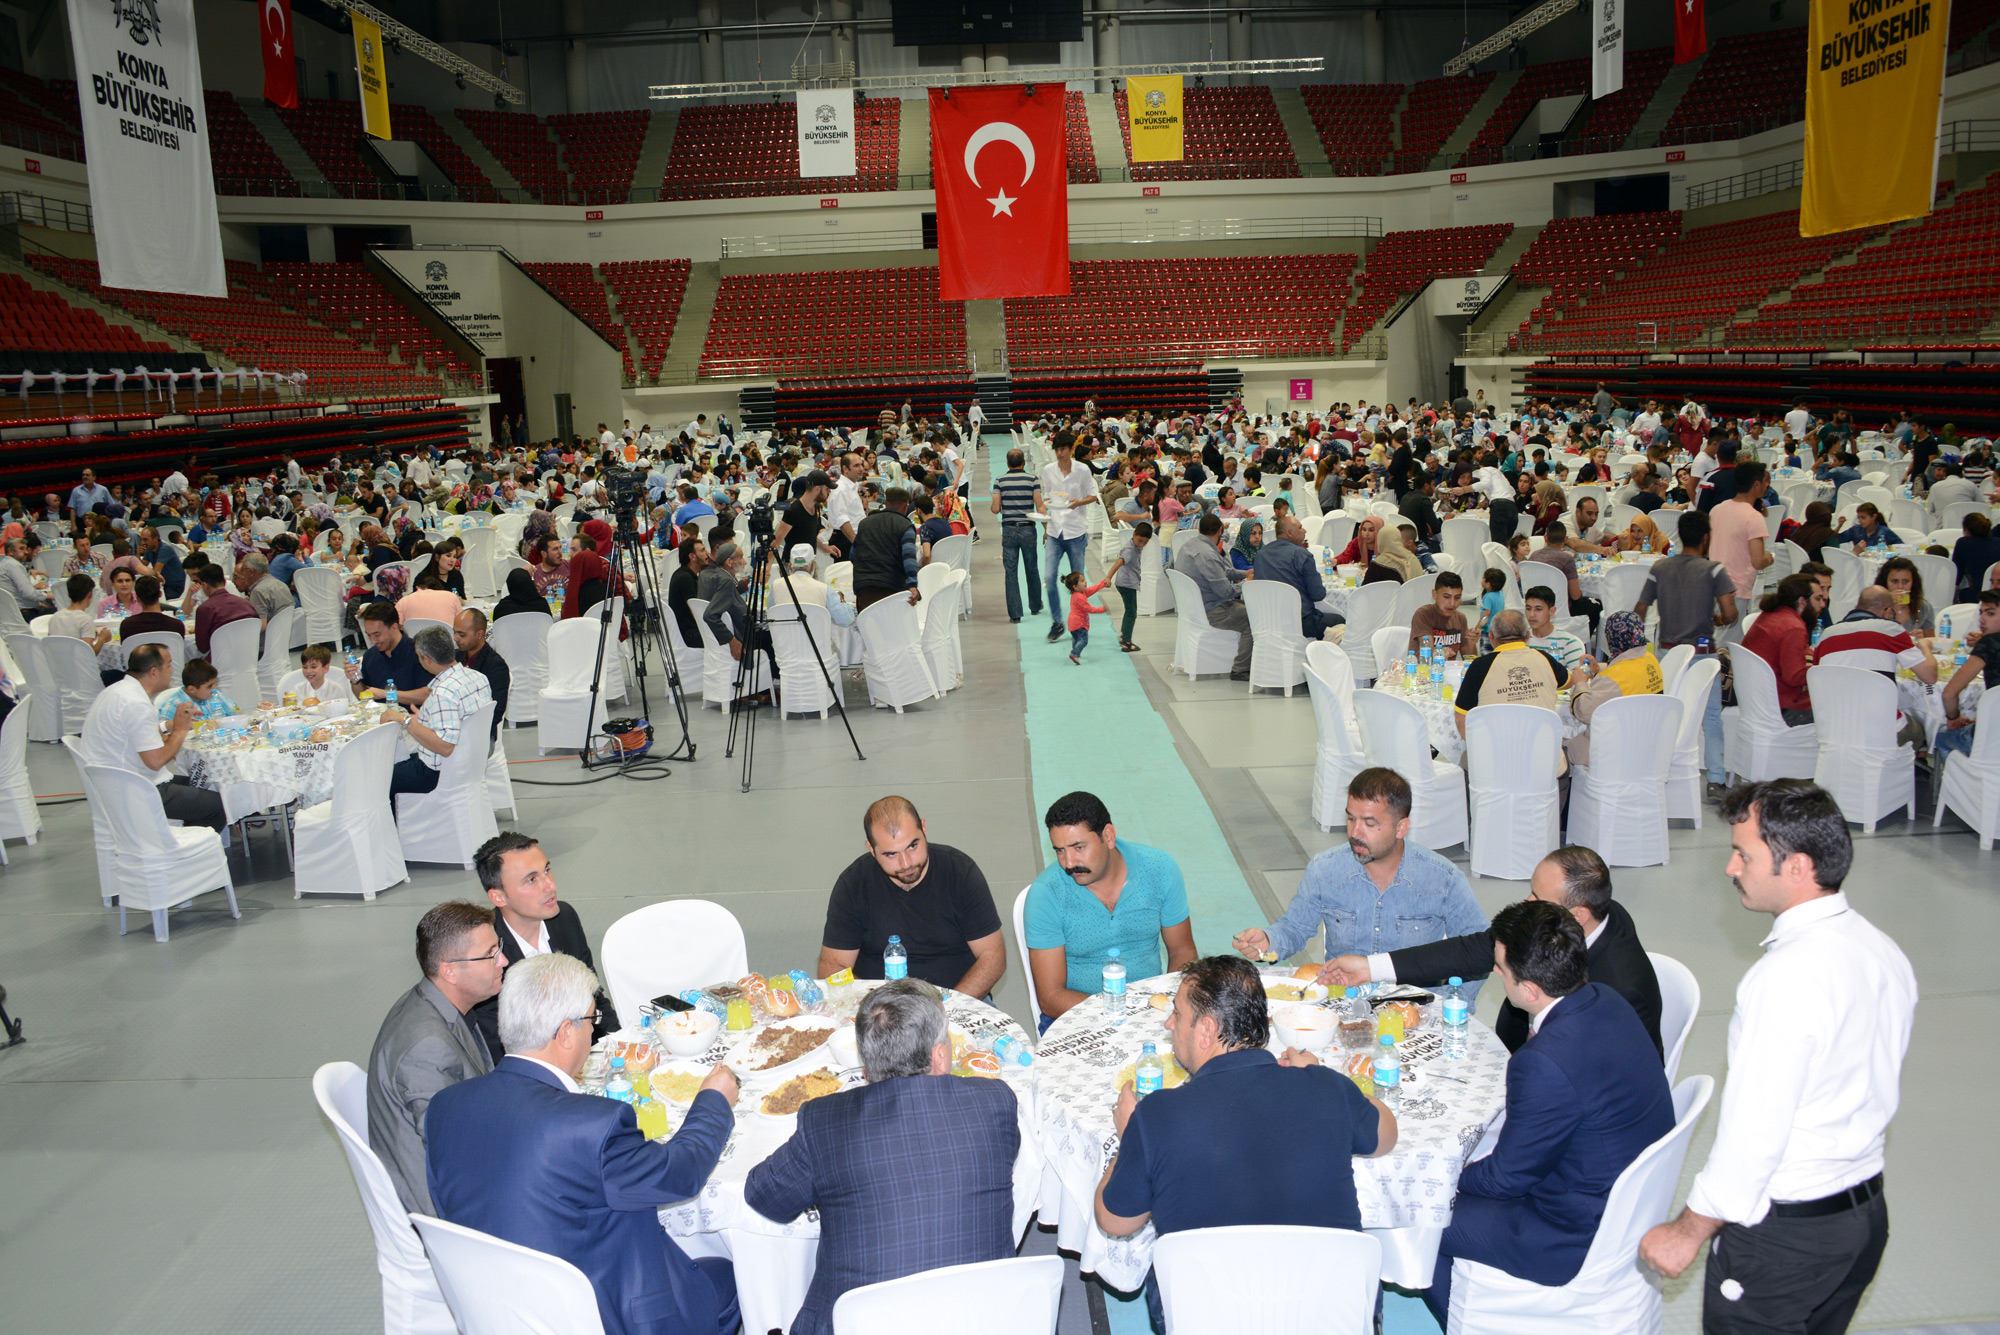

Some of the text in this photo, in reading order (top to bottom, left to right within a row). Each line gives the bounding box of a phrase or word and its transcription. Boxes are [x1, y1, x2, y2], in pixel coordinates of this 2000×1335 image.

[1849, 0, 1905, 25] KON
[1820, 0, 1931, 72] BÜYÜKŞEHİR
[117, 49, 169, 90] KONYA
[1840, 43, 1907, 88] BELEDİYESİ
[92, 71, 197, 134] BÜYÜKŞEHİR
[1134, 115, 1178, 125] BÜYÜKŞEHİR
[119, 117, 181, 152] BELEDİYESİ
[804, 130, 849, 140] BÜYÜKŞEHİR
[1667, 153, 1678, 161] ALT
[473, 313, 502, 321] Dilerim.
[478, 330, 502, 338] Akyürek
[1496, 681, 1545, 695] BÜYÜKŞEHİR
[1508, 678, 1533, 687] KONYA
[292, 751, 315, 759] KONYA
[1035, 1026, 1119, 1059] BÜYÜKŞEHİR
[1066, 1040, 1109, 1057] KONYA
[1399, 1033, 1439, 1050] KONYA
